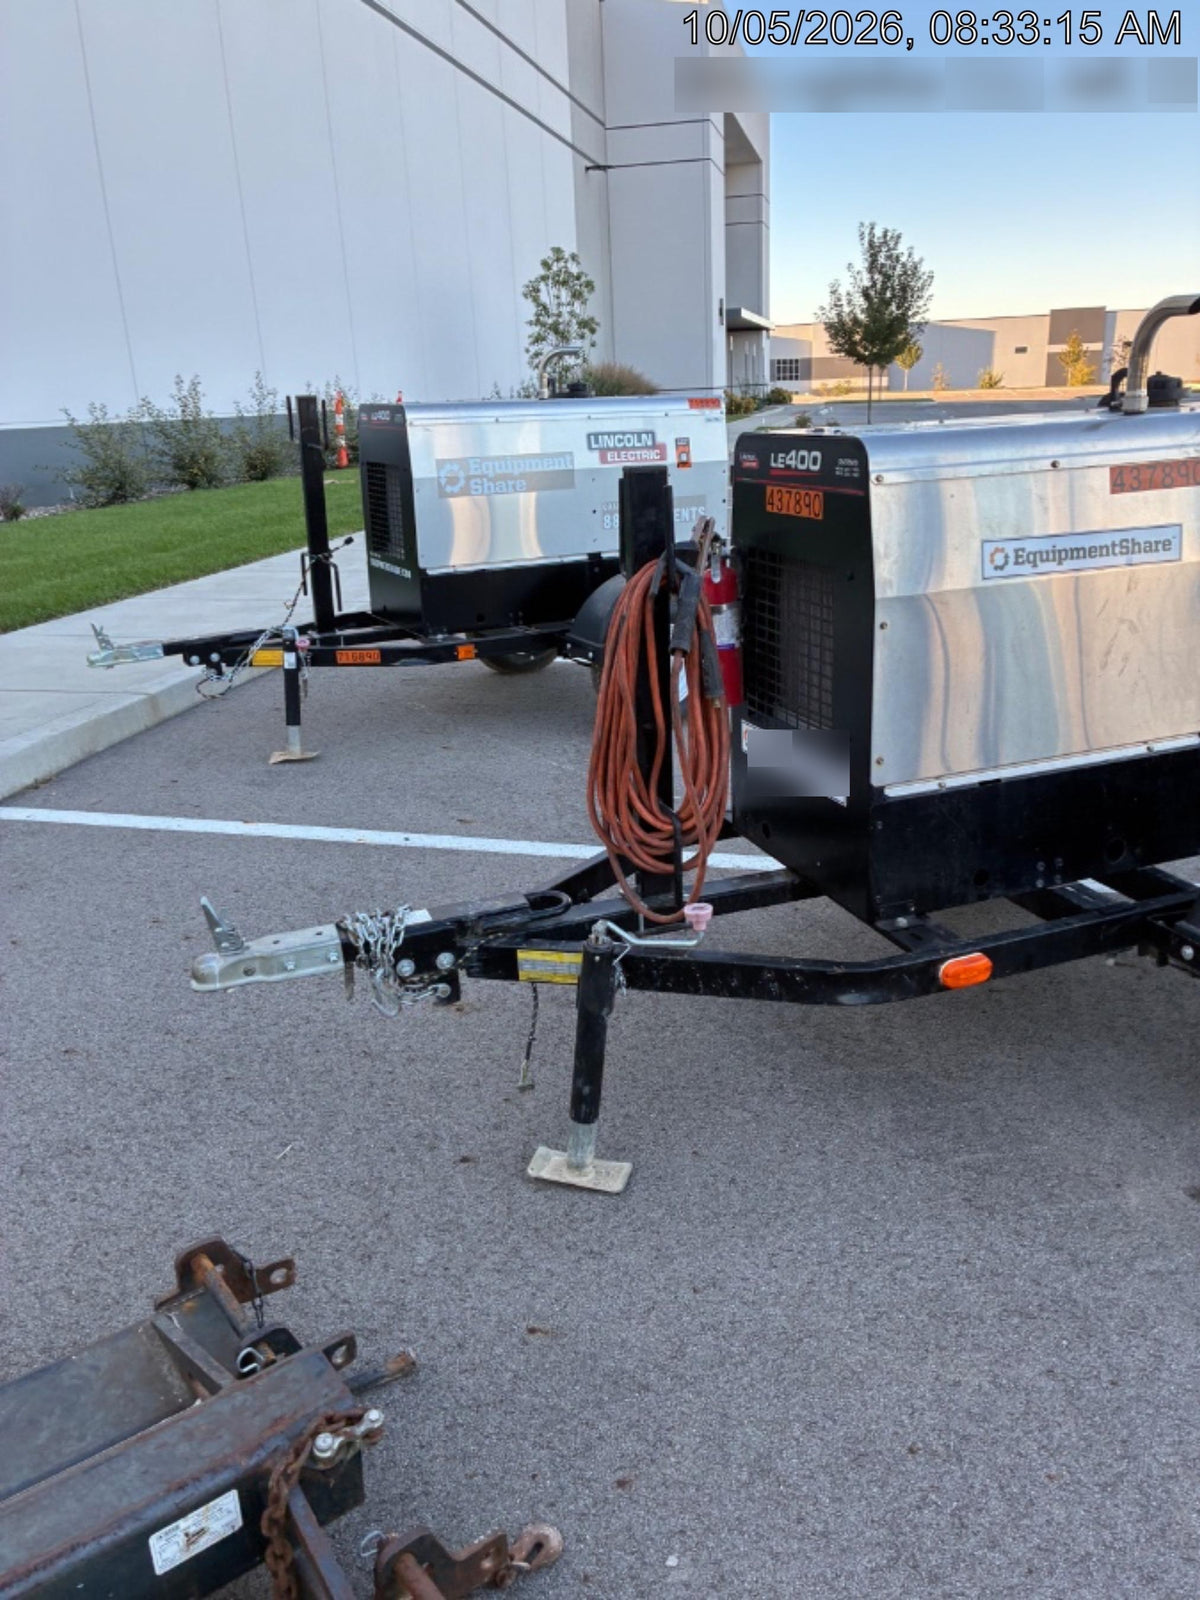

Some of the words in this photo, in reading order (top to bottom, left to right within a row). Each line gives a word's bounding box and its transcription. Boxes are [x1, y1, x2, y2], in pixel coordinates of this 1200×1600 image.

[589, 433, 652, 449] LINCOLN
[467, 454, 573, 478] Equipment
[607, 449, 660, 462] ELECTRIC
[770, 449, 822, 471] LE400
[469, 478, 528, 495] Share
[767, 488, 822, 518] 437890
[1013, 537, 1173, 567] EquipmentShare
